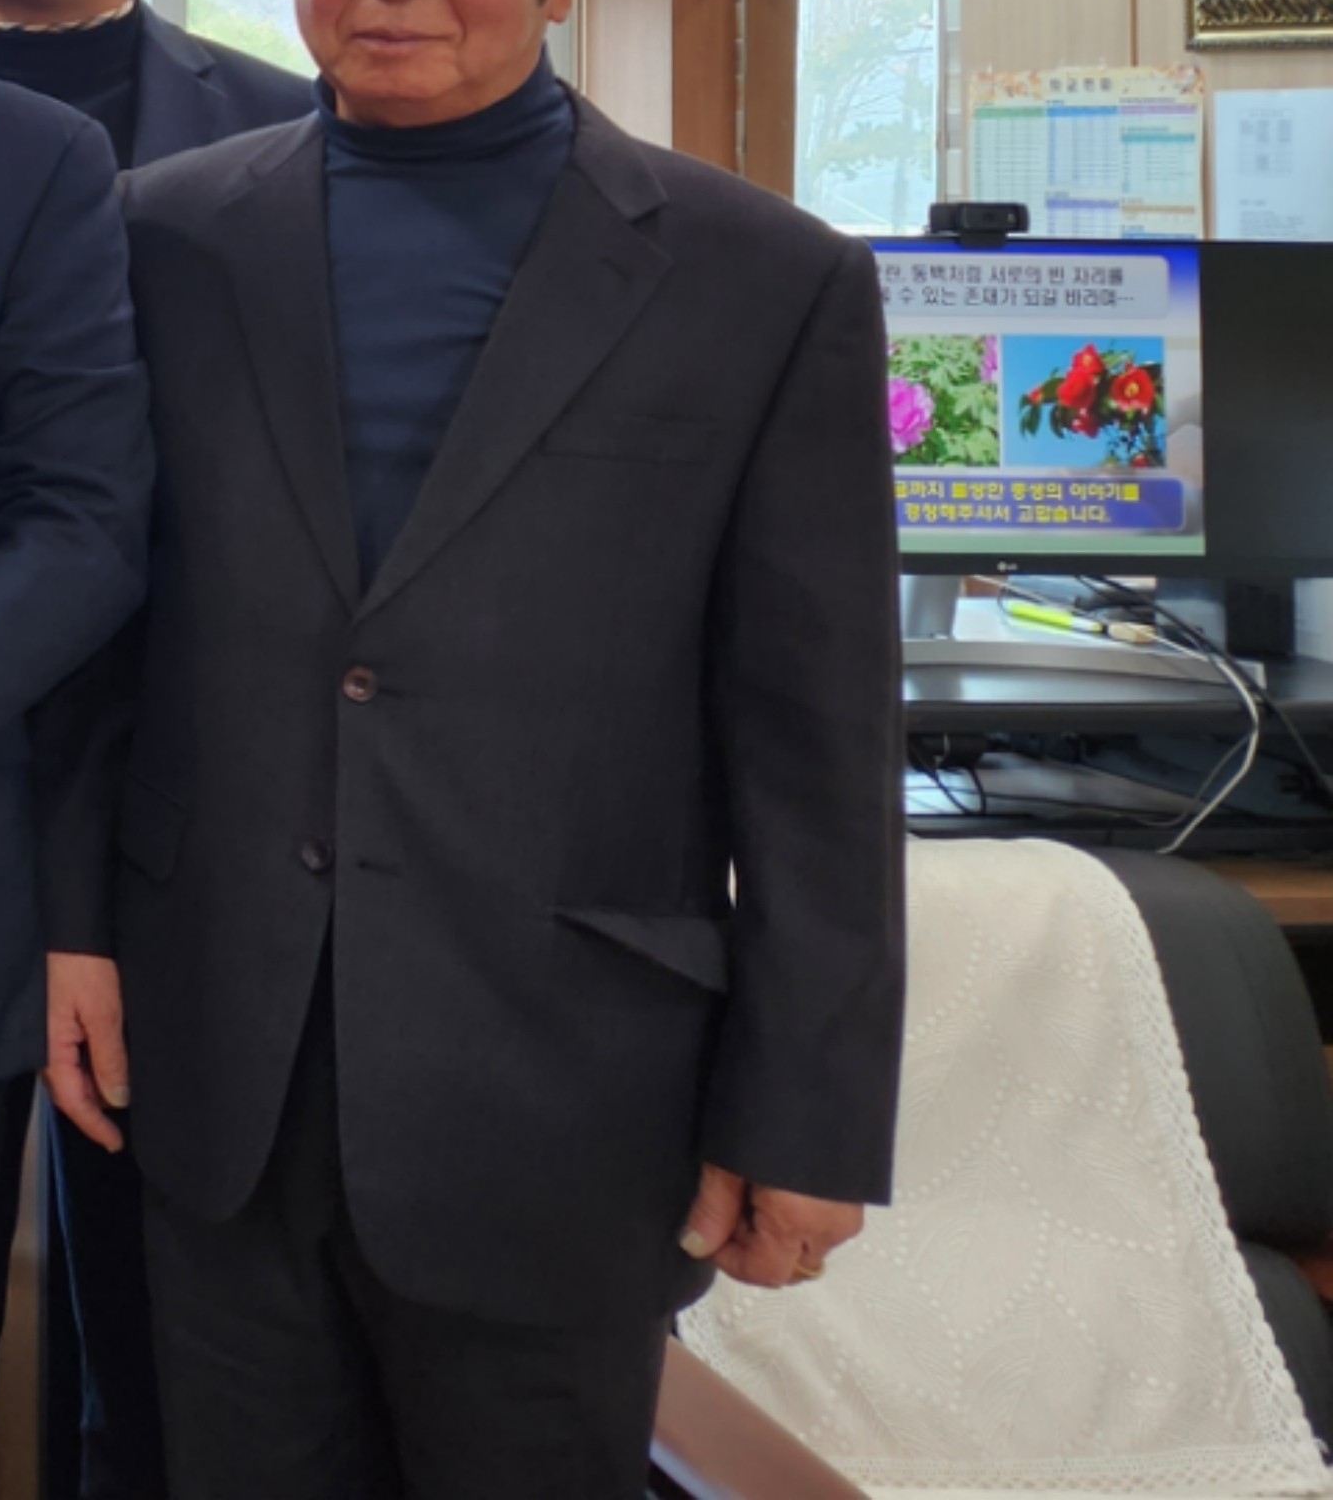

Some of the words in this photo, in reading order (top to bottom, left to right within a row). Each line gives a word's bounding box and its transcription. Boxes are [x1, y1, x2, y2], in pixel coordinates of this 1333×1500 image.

[990, 265, 1042, 285] 서로의
[921, 286, 957, 306] 있는
[965, 286, 1018, 306] 존재가
